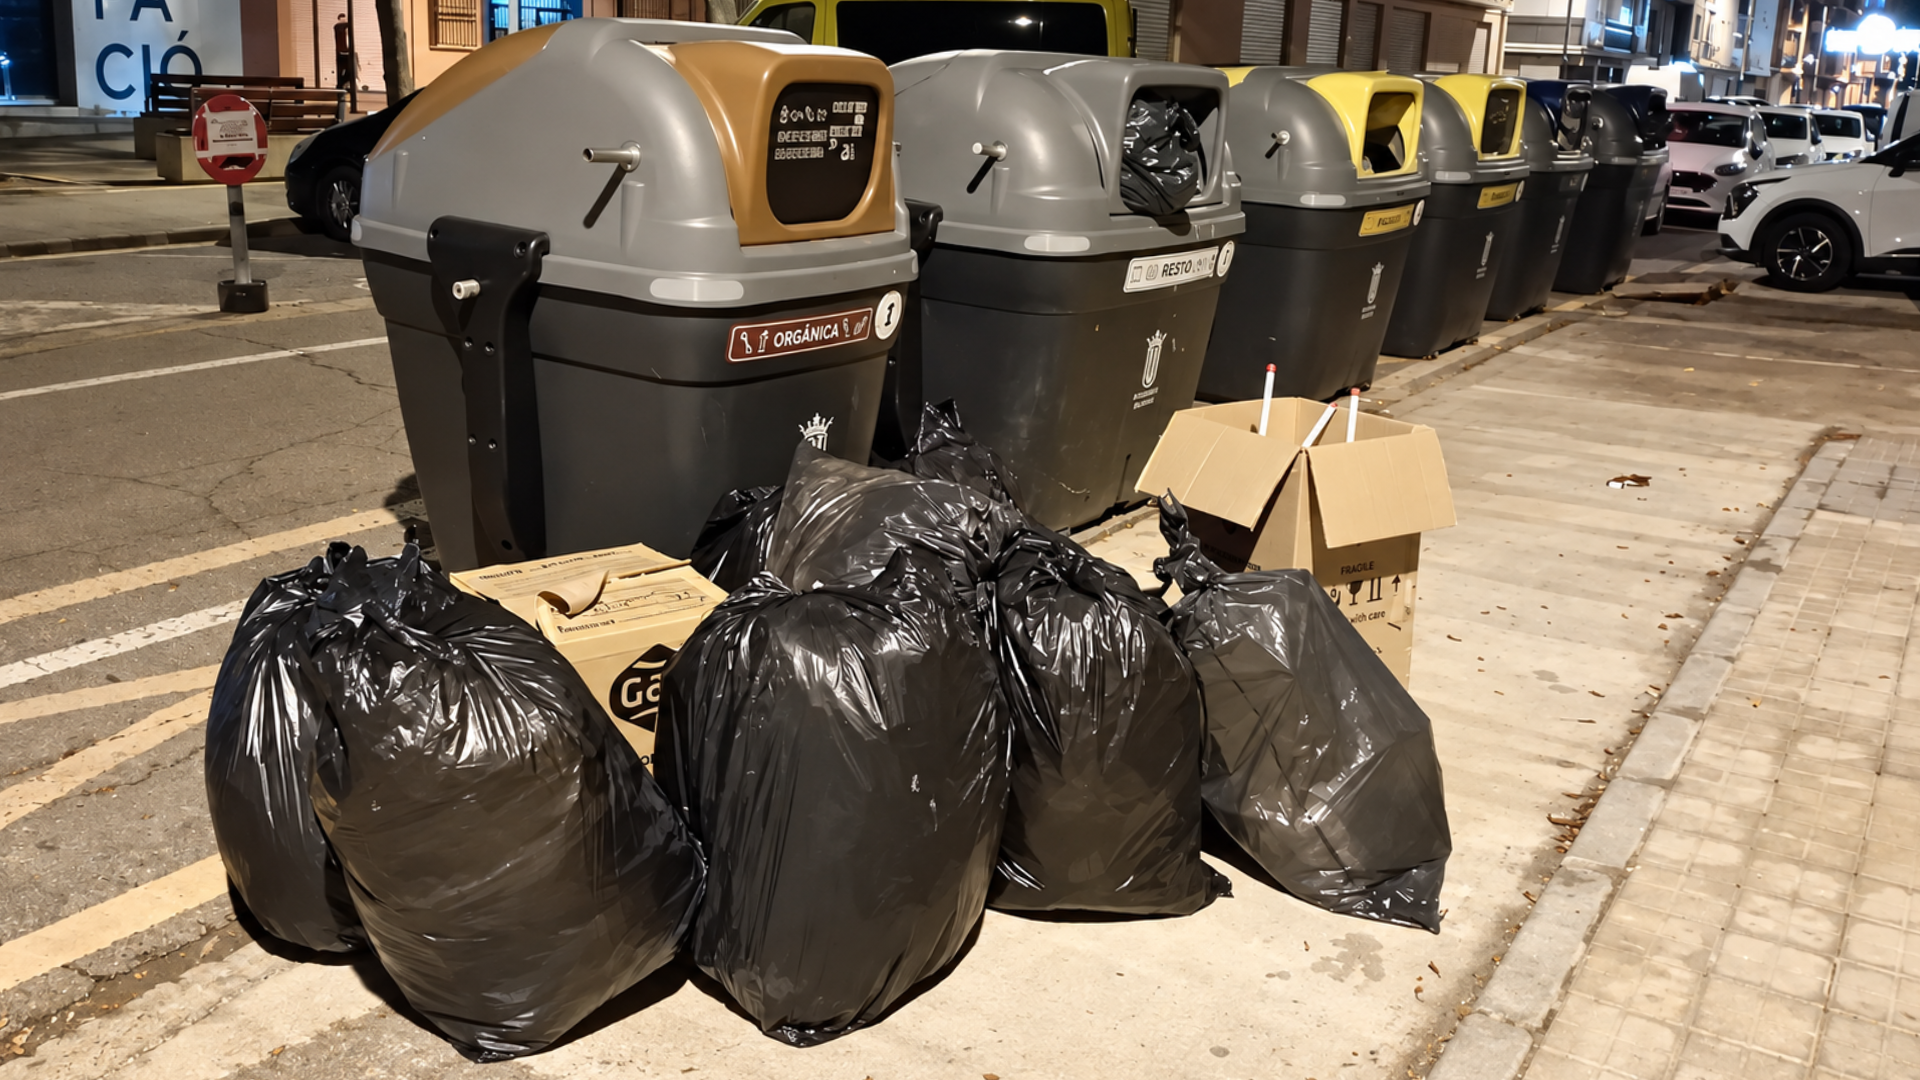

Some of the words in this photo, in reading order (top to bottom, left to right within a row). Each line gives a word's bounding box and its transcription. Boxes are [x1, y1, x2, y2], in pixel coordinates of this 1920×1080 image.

[95, 29, 203, 101] CIÓ
[1161, 259, 1193, 278] RESTO
[773, 323, 839, 348] ORGÁNICA
[1340, 560, 1375, 576] FRAGILE
